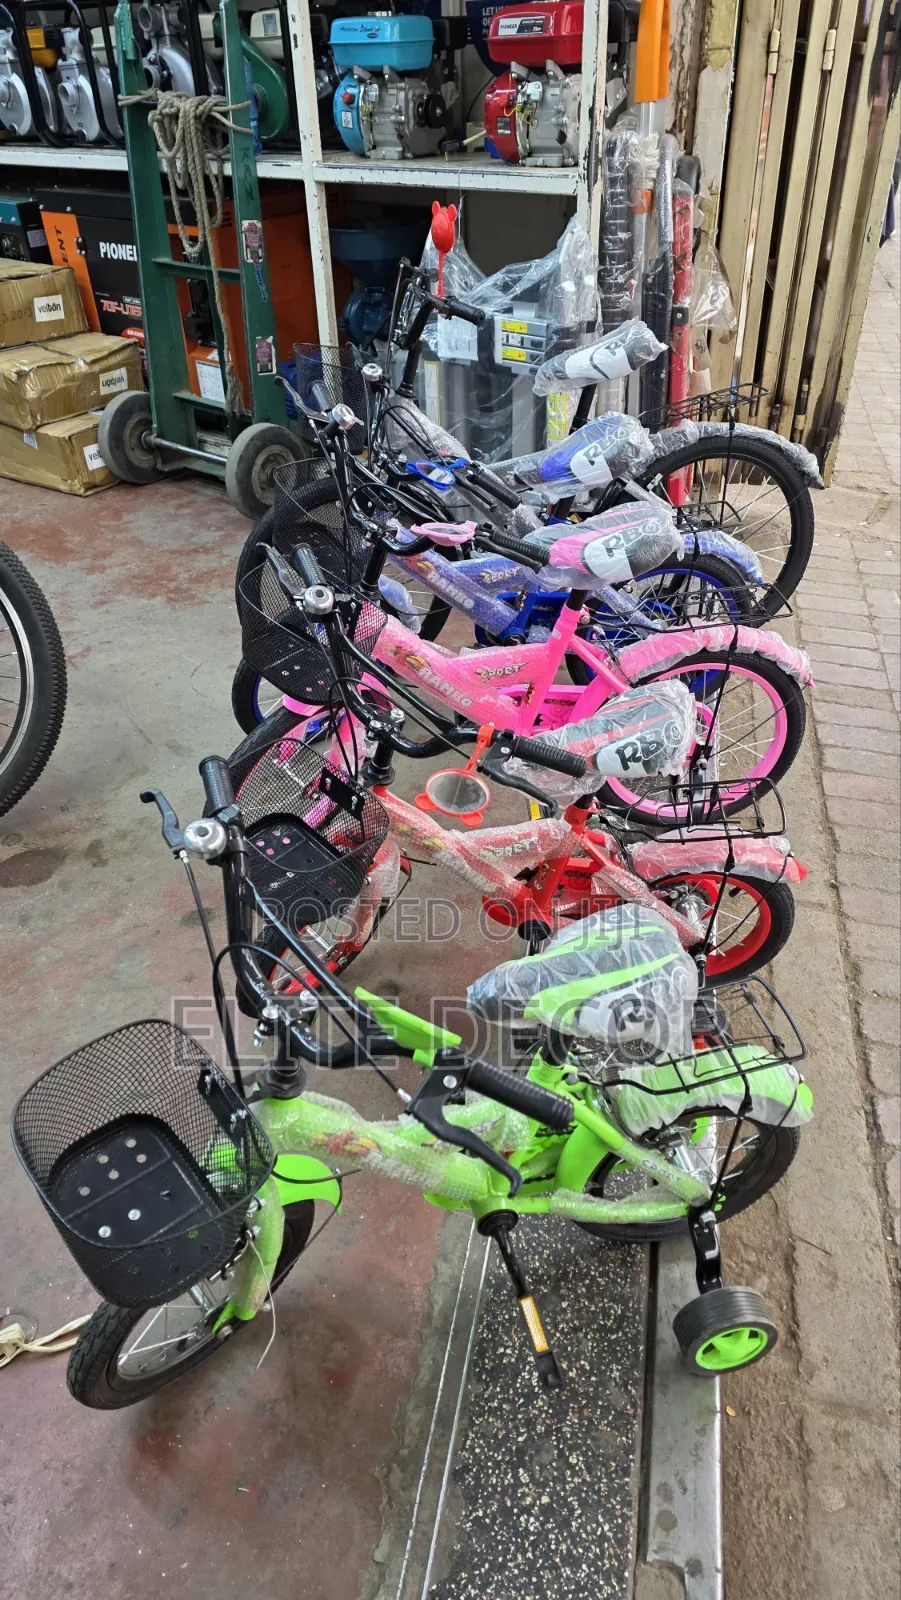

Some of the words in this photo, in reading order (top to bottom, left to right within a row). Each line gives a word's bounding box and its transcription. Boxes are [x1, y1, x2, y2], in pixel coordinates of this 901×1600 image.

[54, 225, 69, 264] ENT
[601, 520, 661, 558] RBO
[426, 571, 475, 609] RAMBO
[418, 666, 473, 708] RAMBO
[480, 664, 523, 681] SPORT
[615, 719, 685, 771] RBO
